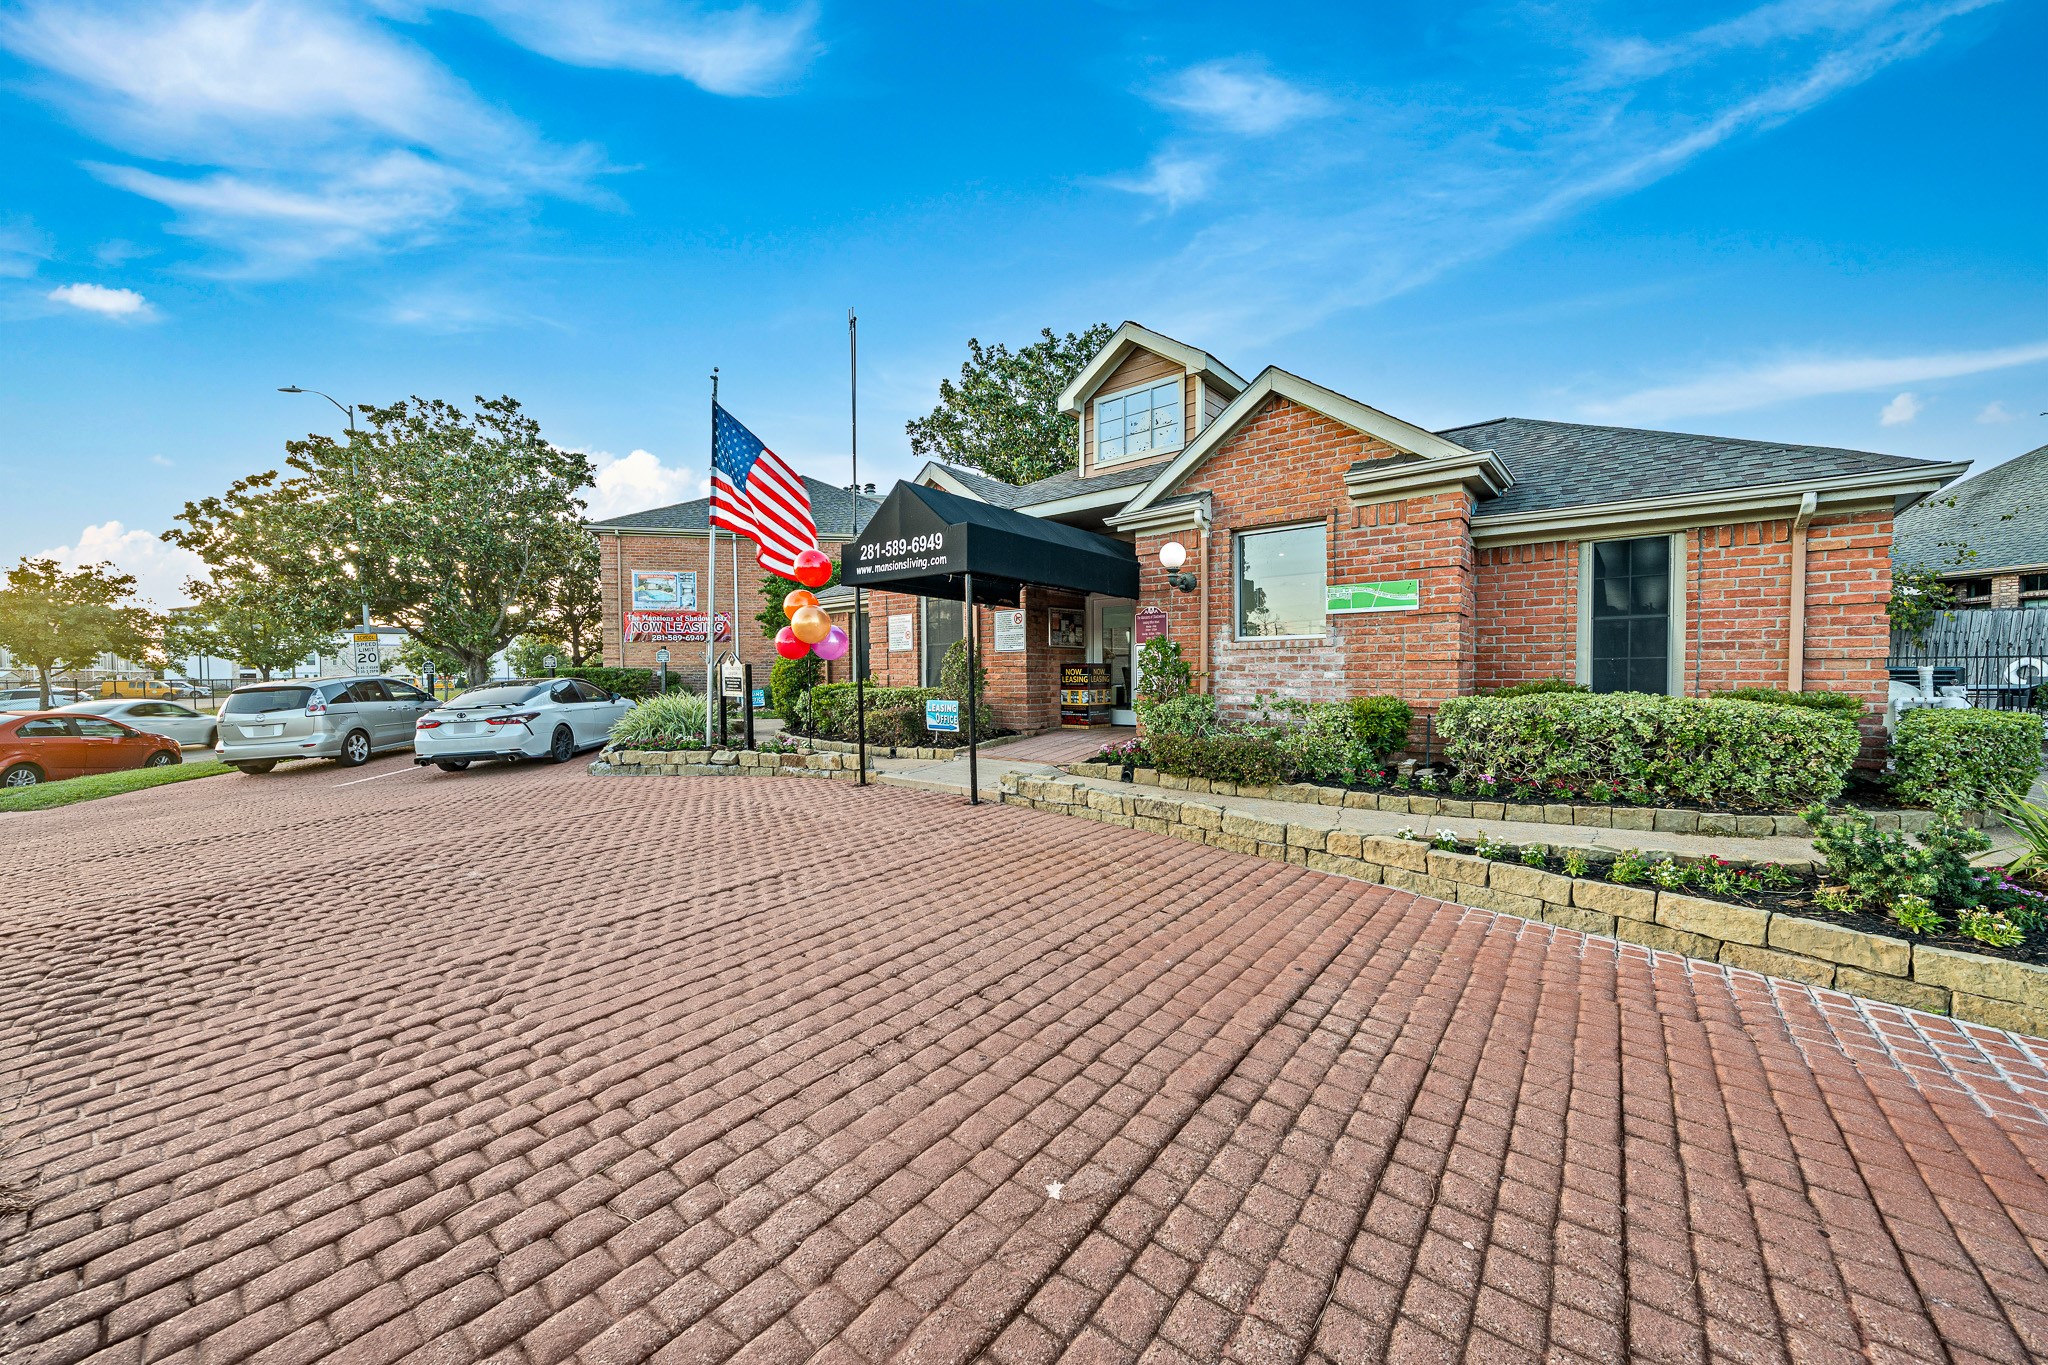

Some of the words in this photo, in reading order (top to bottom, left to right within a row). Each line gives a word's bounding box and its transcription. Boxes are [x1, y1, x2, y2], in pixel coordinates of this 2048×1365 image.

[860, 532, 943, 561] 281-589-6949
[856, 555, 947, 575] www.mansionsliving.com
[632, 621, 662, 633] NOW
[666, 622, 724, 633] LEASIG
[358, 653, 377, 663] 20
[928, 702, 956, 712] LEASING
[936, 713, 958, 724] OFFICE
